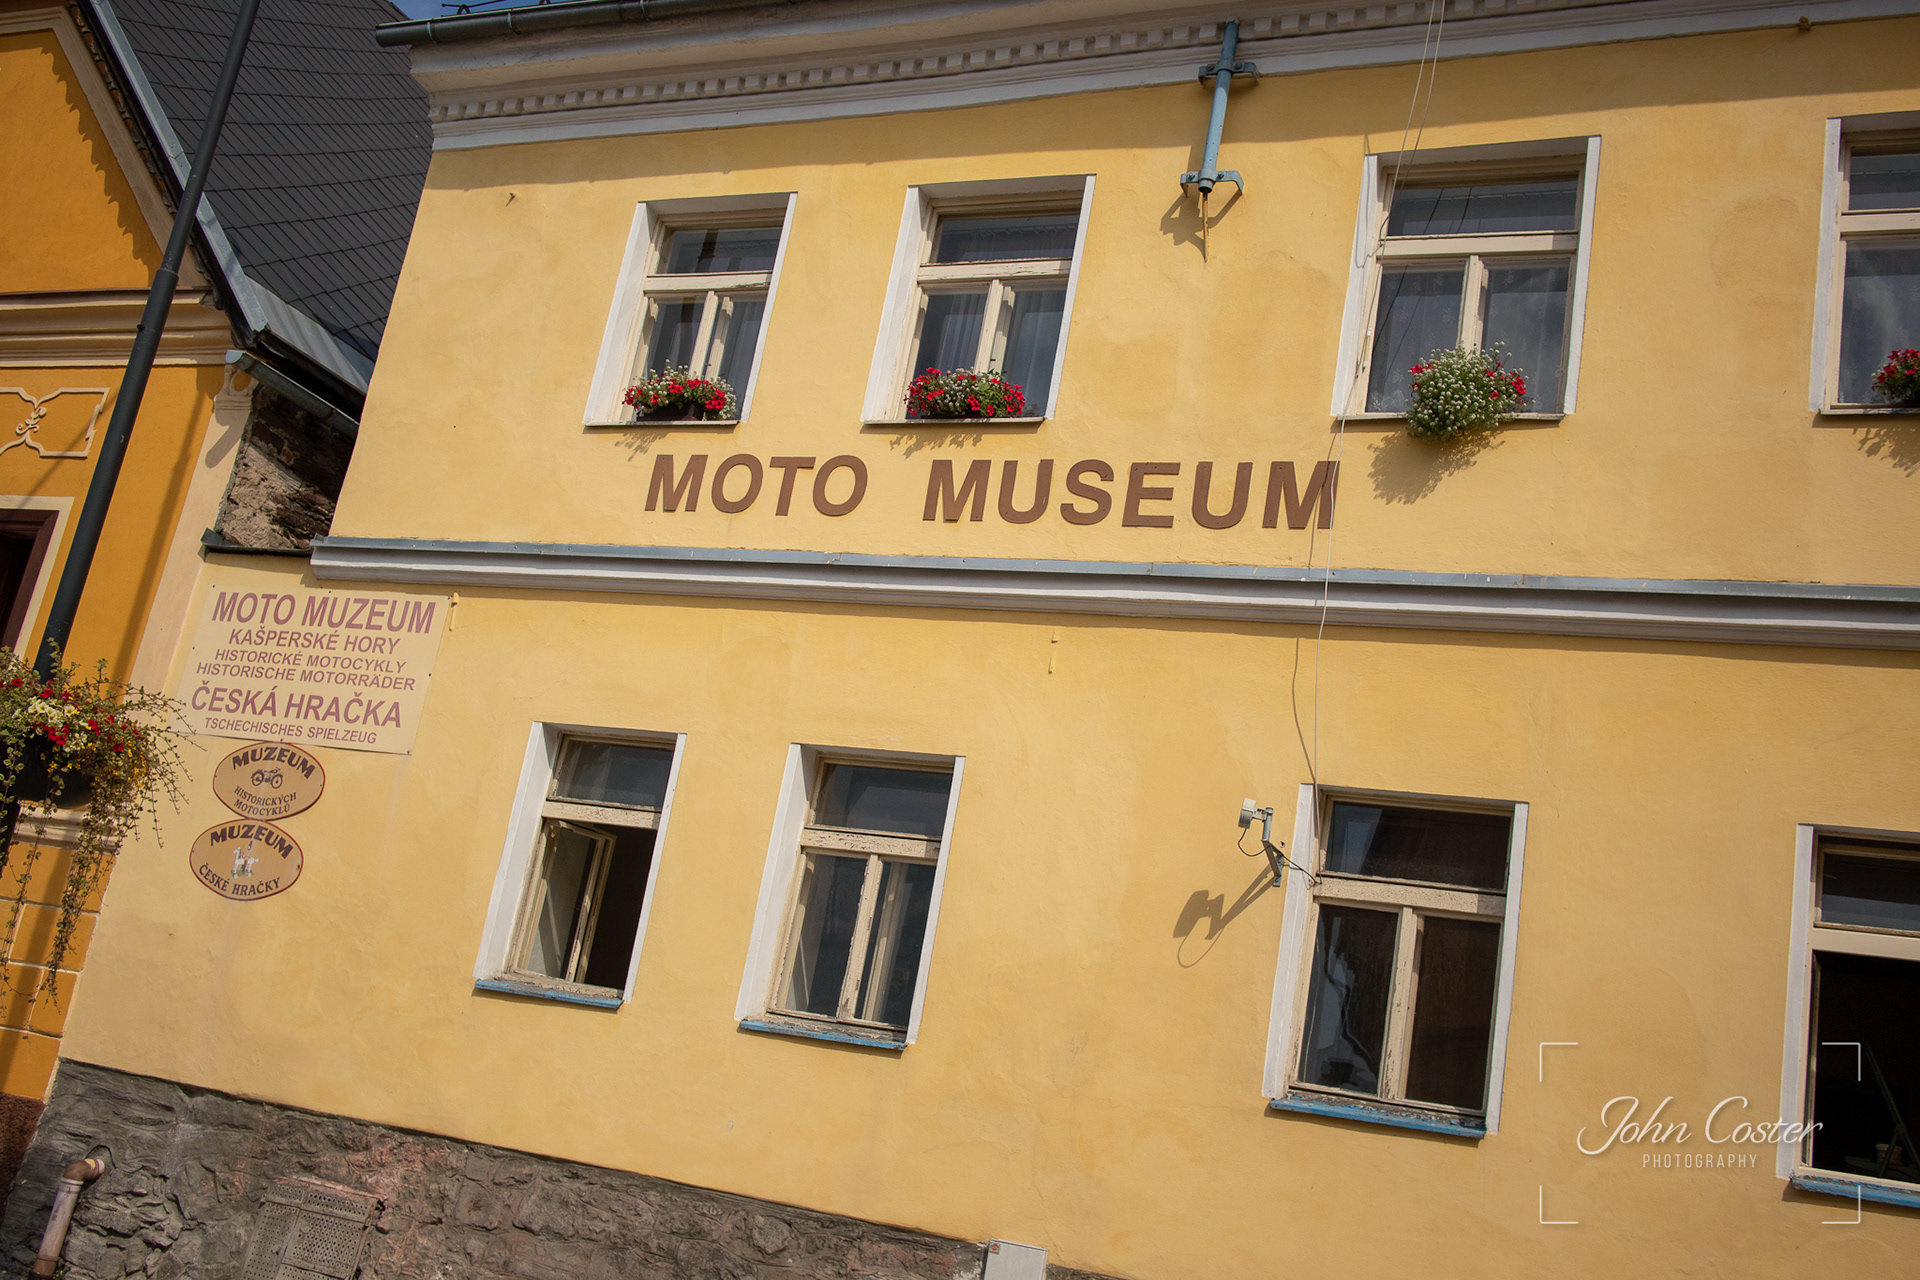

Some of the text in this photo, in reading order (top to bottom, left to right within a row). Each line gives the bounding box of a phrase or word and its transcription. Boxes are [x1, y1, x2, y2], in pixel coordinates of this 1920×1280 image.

[644, 454, 1340, 531] MOTO MUSEUM
[212, 591, 436, 634] MOTO MUZEUM
[229, 626, 400, 655] KAŠPERSKÉ HORY
[196, 662, 415, 691] HISTORISCHE MOTORRÄDER
[215, 649, 406, 674] HISTORICKÉ MOTOCYKLY
[191, 680, 401, 728] ČESKÁ HRAČKA
[204, 717, 377, 744] TSCHECHISCHES SPIELZEUG
[232, 747, 316, 779] MUZEUM
[233, 785, 297, 806] HISTORICKÝCH
[233, 799, 290, 816] MOTOCYKLŮ
[210, 824, 294, 859] MUZEUM
[199, 862, 281, 896] ČESKÉ HRAČKY
